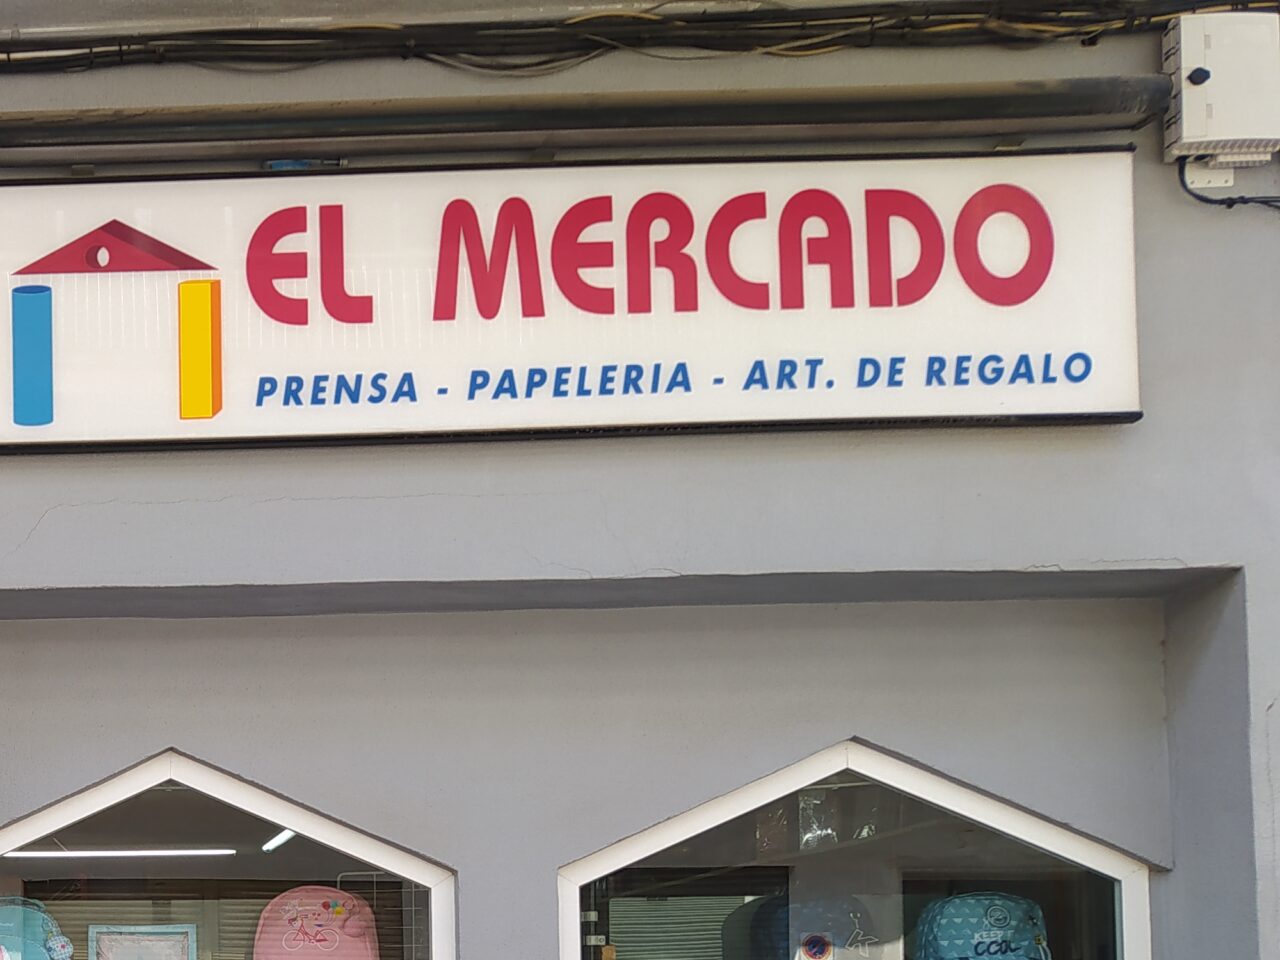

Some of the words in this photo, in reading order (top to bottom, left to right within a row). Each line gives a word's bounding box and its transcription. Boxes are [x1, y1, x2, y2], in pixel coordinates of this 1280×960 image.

[245, 204, 374, 326] EL
[432, 183, 1055, 321] MERCADO
[255, 372, 418, 407] PRENSA
[467, 362, 693, 401] PAPELERIA
[741, 358, 835, 390] ART.
[856, 357, 907, 388] DE
[925, 352, 1093, 386] REGALO
